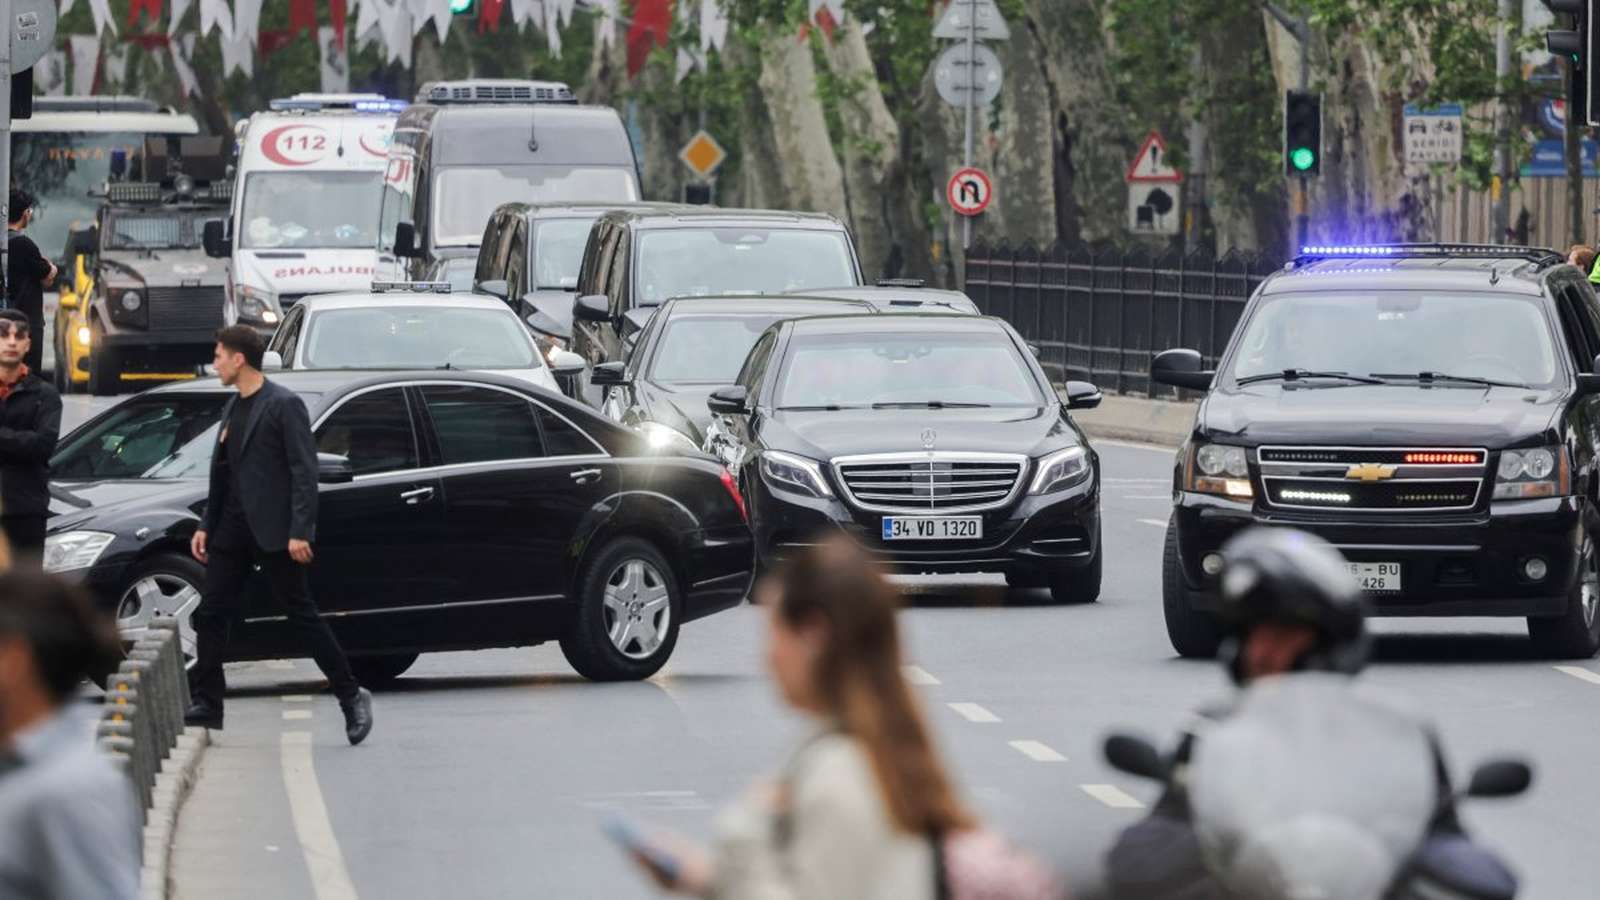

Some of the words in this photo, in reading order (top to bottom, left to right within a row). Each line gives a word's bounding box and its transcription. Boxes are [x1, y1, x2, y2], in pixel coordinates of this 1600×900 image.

[283, 135, 326, 150] 112
[893, 521, 910, 536] 34
[917, 521, 935, 536] VD
[942, 521, 977, 536] 1320
[1378, 564, 1399, 576] BU
[1357, 577, 1385, 589] 426
